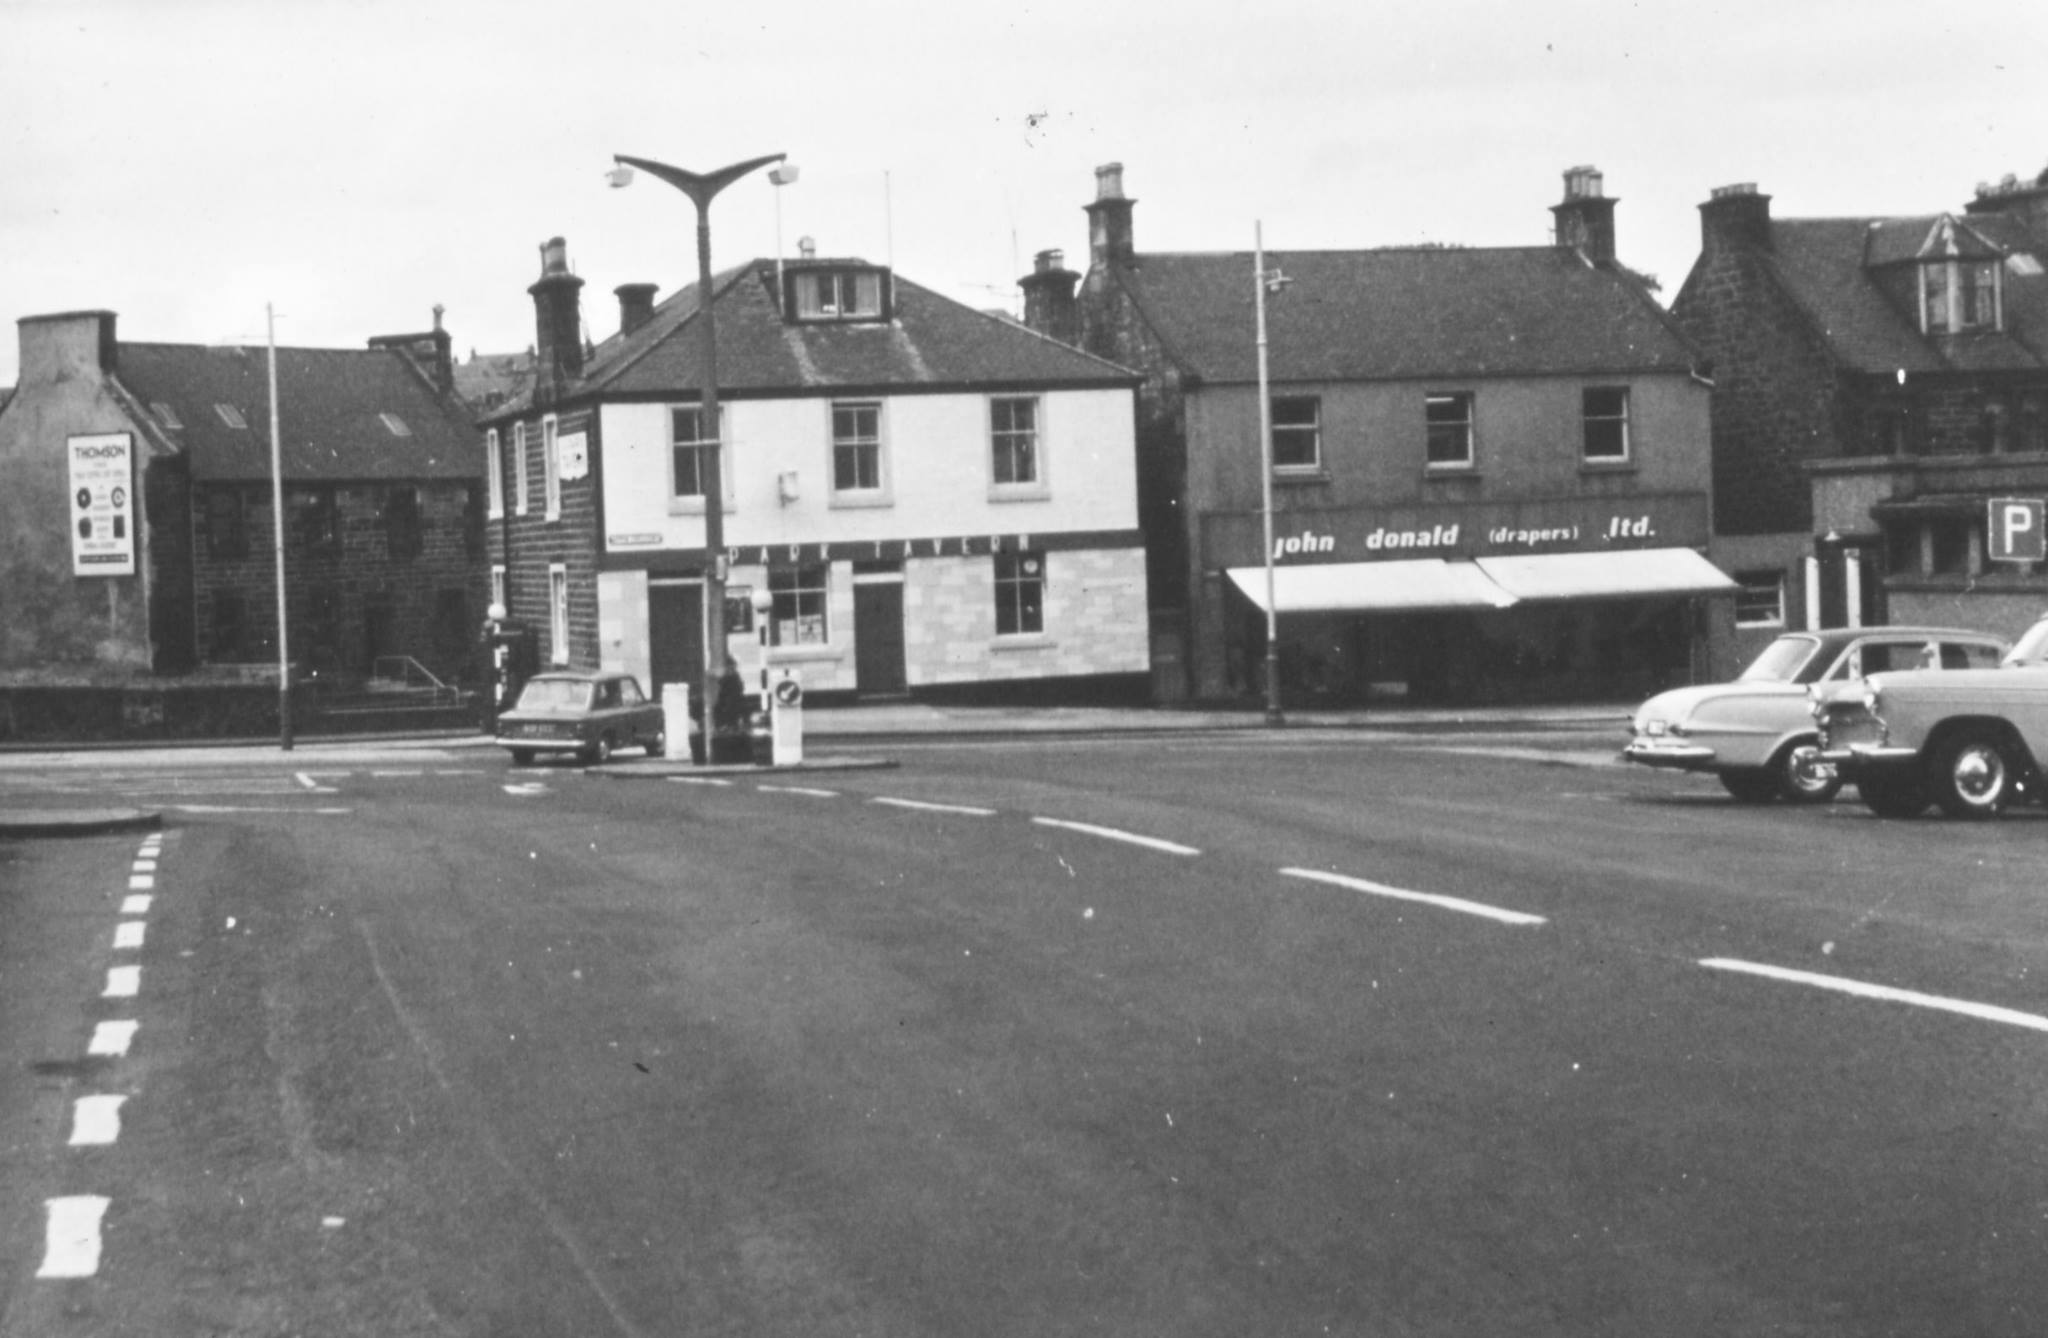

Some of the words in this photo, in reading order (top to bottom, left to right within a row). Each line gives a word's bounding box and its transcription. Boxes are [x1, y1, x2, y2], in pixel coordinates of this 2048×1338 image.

[74, 444, 126, 461] THOMSON
[1273, 530, 1336, 559] john
[1366, 523, 1460, 549] donald
[1489, 524, 1580, 547] (drapers)
[1608, 515, 1657, 538] ltd.
[2005, 505, 2031, 554] P
[729, 543, 829, 566] PARK
[875, 534, 1029, 560] TAVERN
